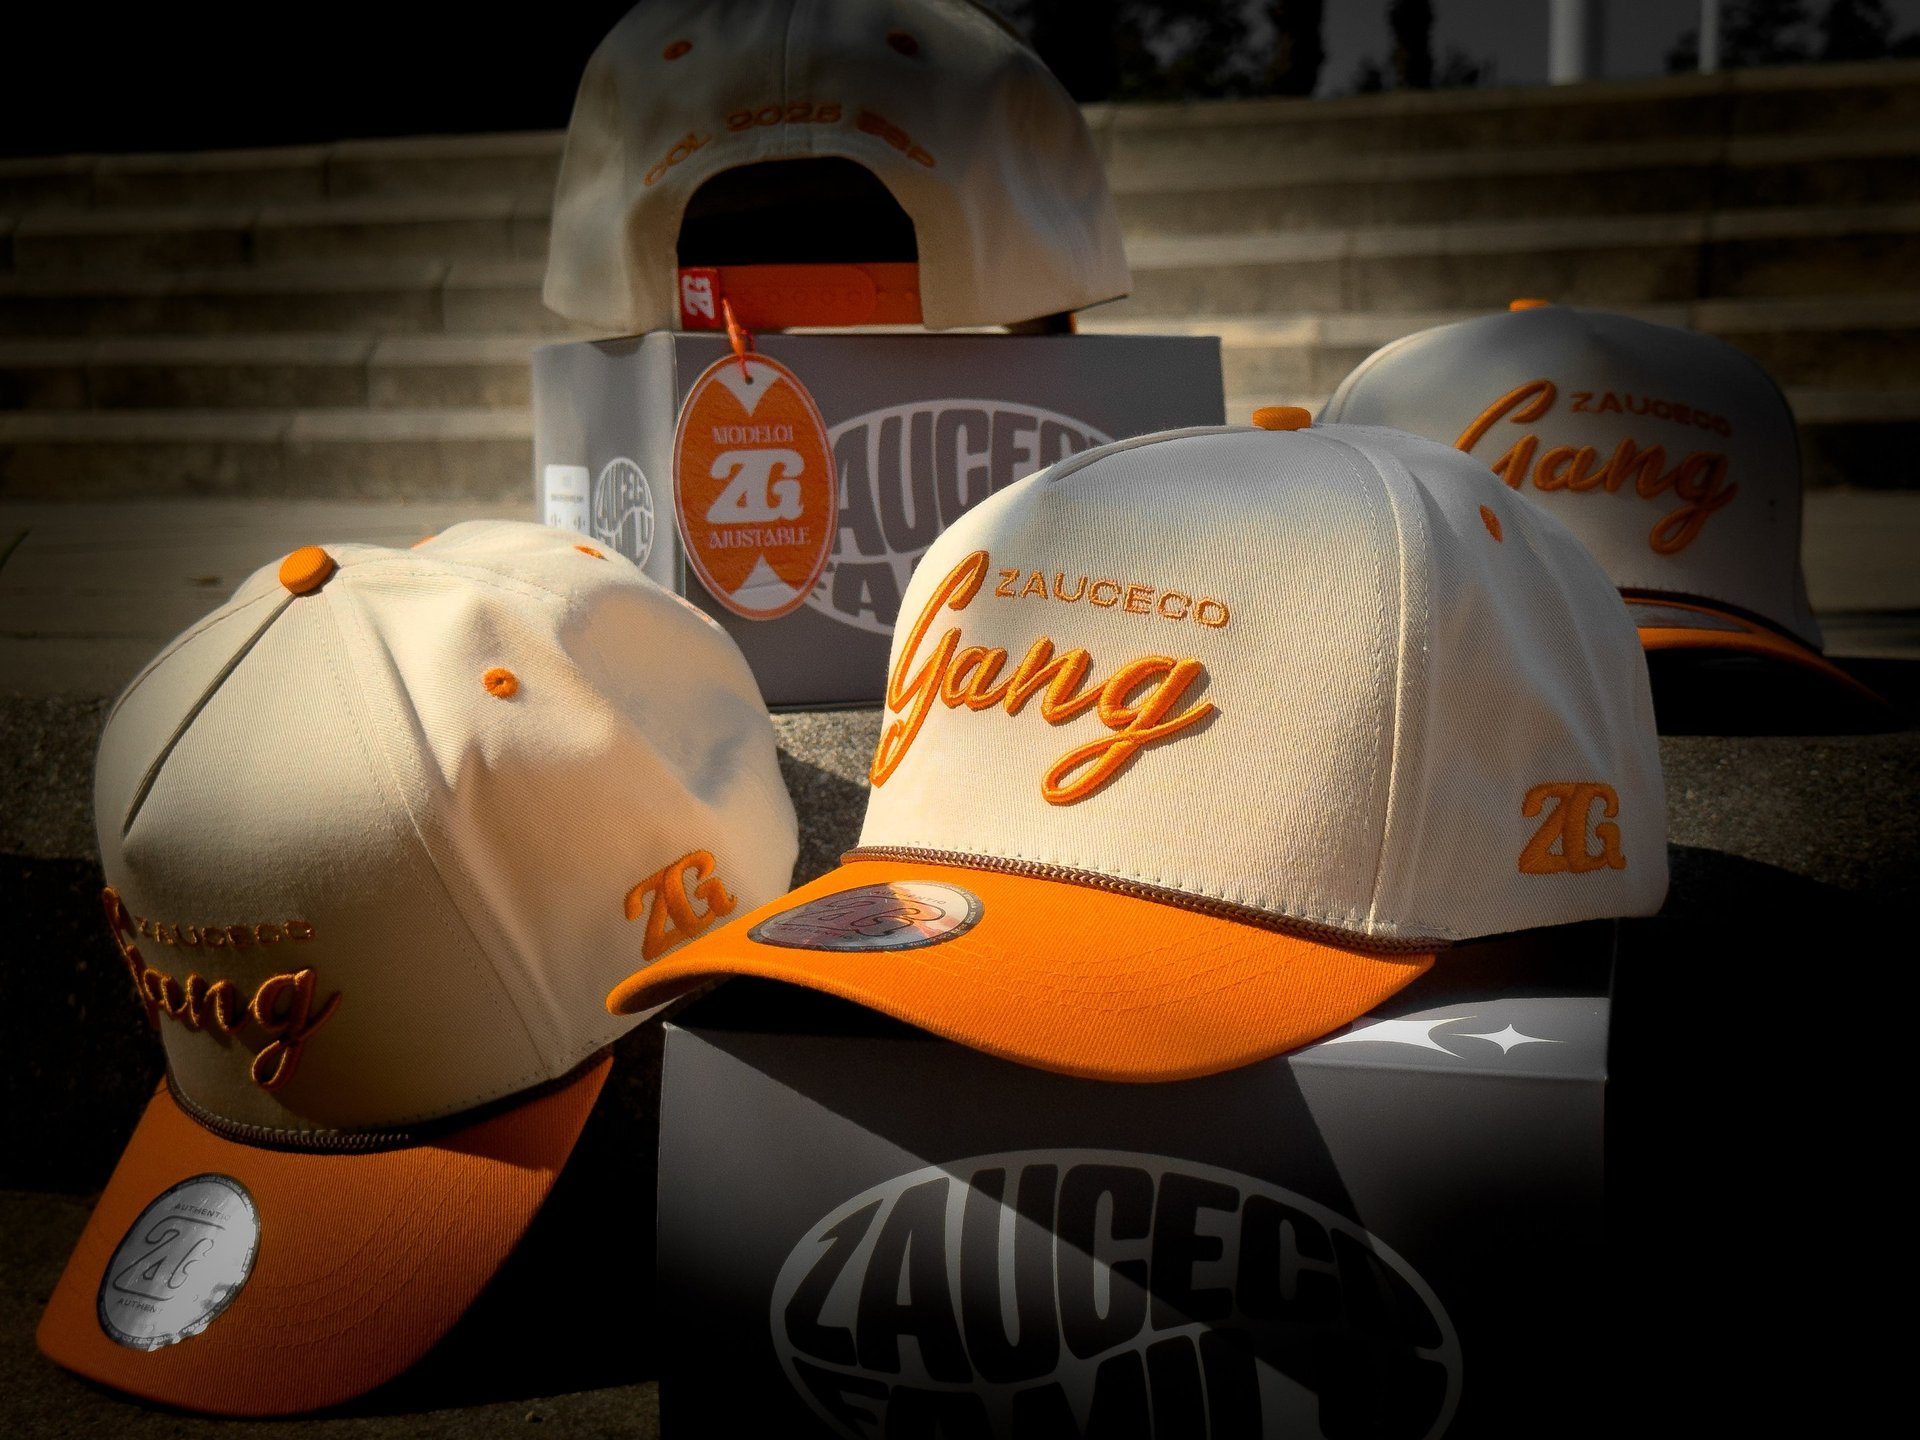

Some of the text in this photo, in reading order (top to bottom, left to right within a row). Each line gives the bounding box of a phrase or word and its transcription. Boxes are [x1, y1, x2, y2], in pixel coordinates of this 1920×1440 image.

[1571, 392, 1732, 438] ZAUCECO
[706, 448, 805, 524] ZG
[709, 526, 811, 549] AJUSTABLE
[994, 568, 1231, 628] ZAUCECO
[869, 549, 1214, 806] Gang
[1518, 781, 1626, 874] ZG
[623, 849, 737, 961] ZG
